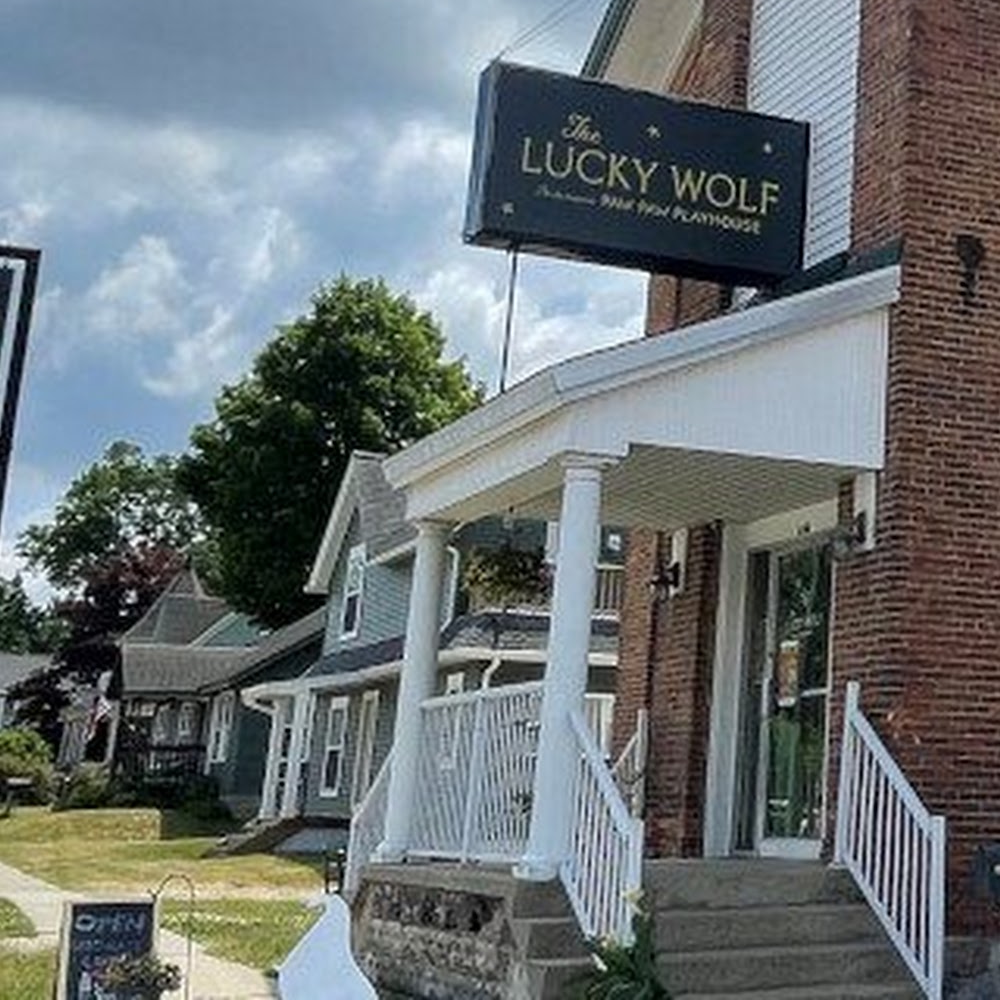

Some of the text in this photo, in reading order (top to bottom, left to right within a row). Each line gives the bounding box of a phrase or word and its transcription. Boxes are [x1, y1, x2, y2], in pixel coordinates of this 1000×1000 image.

[561, 112, 602, 145] The
[521, 137, 780, 216] LUCKY WOLF
